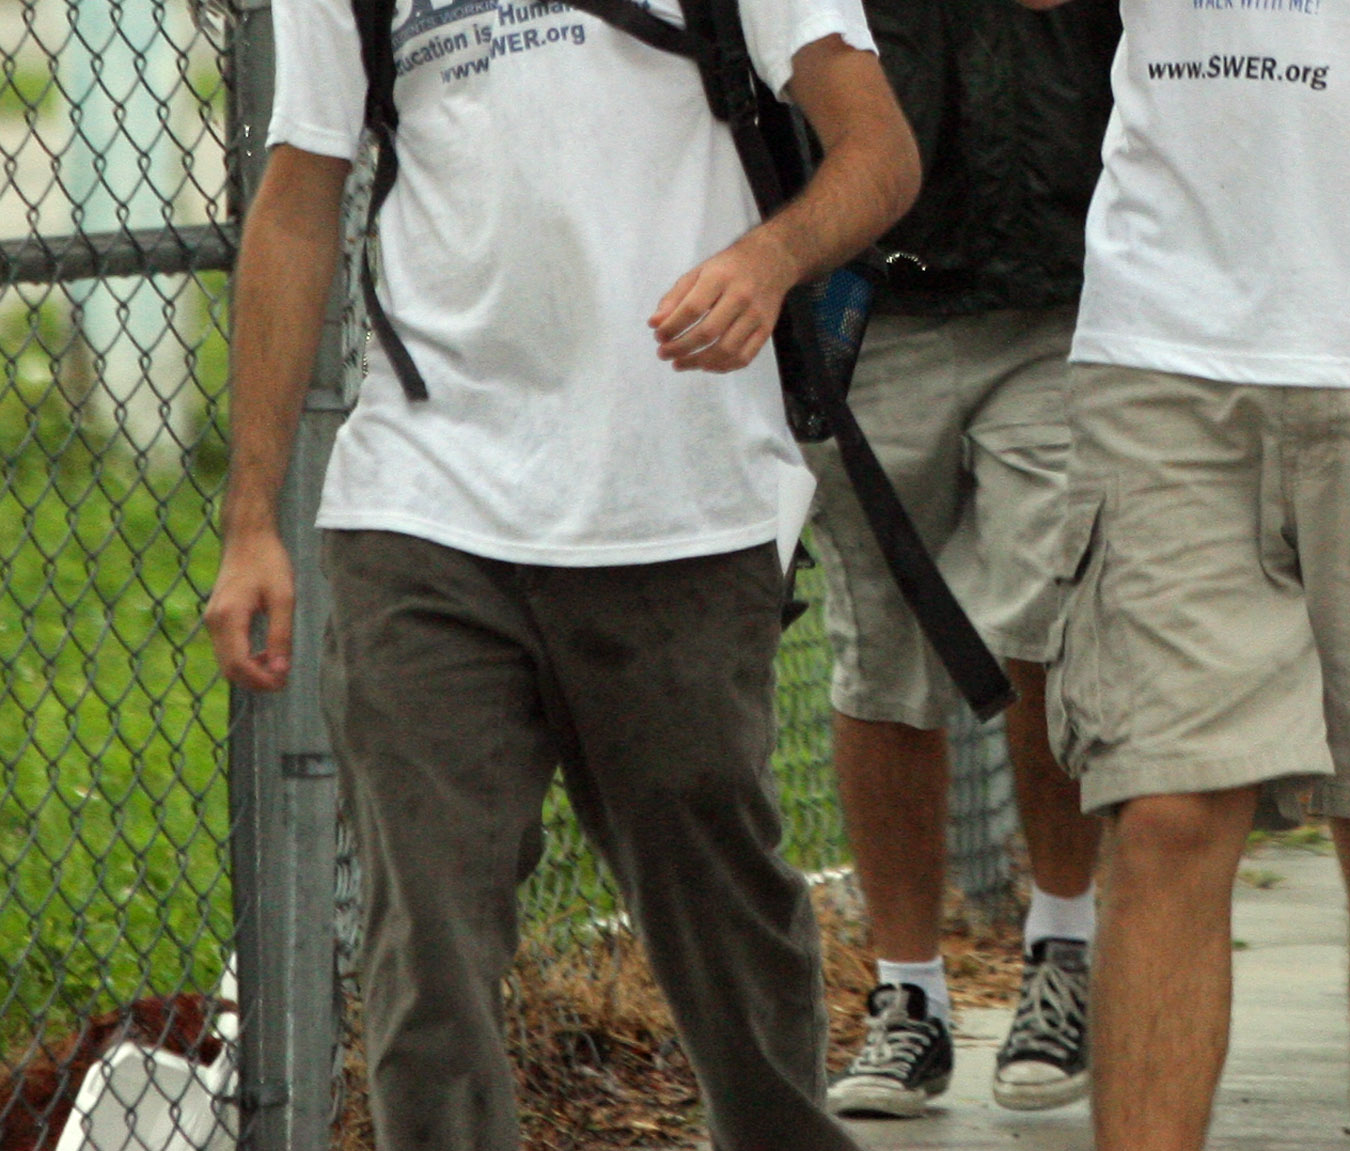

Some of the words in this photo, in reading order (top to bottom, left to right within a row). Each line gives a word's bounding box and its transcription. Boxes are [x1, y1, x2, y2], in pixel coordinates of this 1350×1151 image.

[473, 23, 492, 46] is
[498, 0, 573, 27] Huma
[1147, 54, 1329, 91] www.SWER.org
